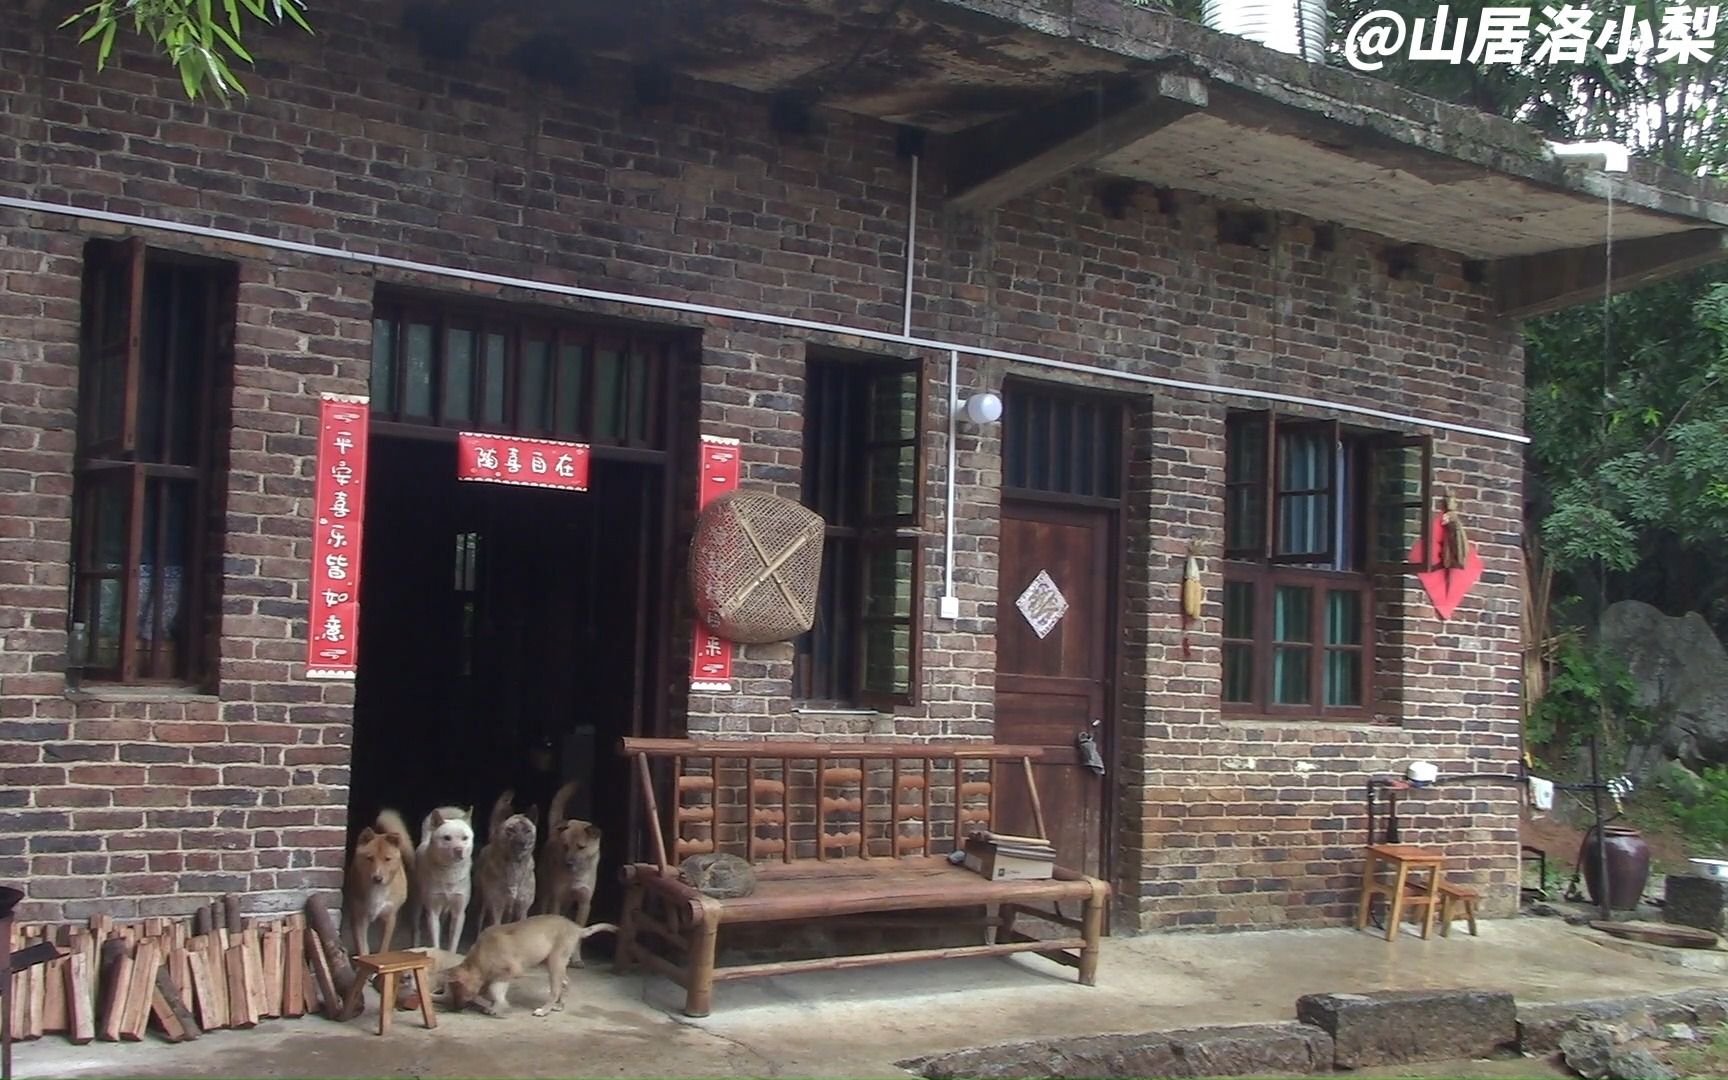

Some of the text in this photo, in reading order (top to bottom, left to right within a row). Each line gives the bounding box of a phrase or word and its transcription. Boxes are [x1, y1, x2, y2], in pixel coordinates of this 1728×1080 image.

[322, 431, 354, 642] 平安喜乐皆如意
